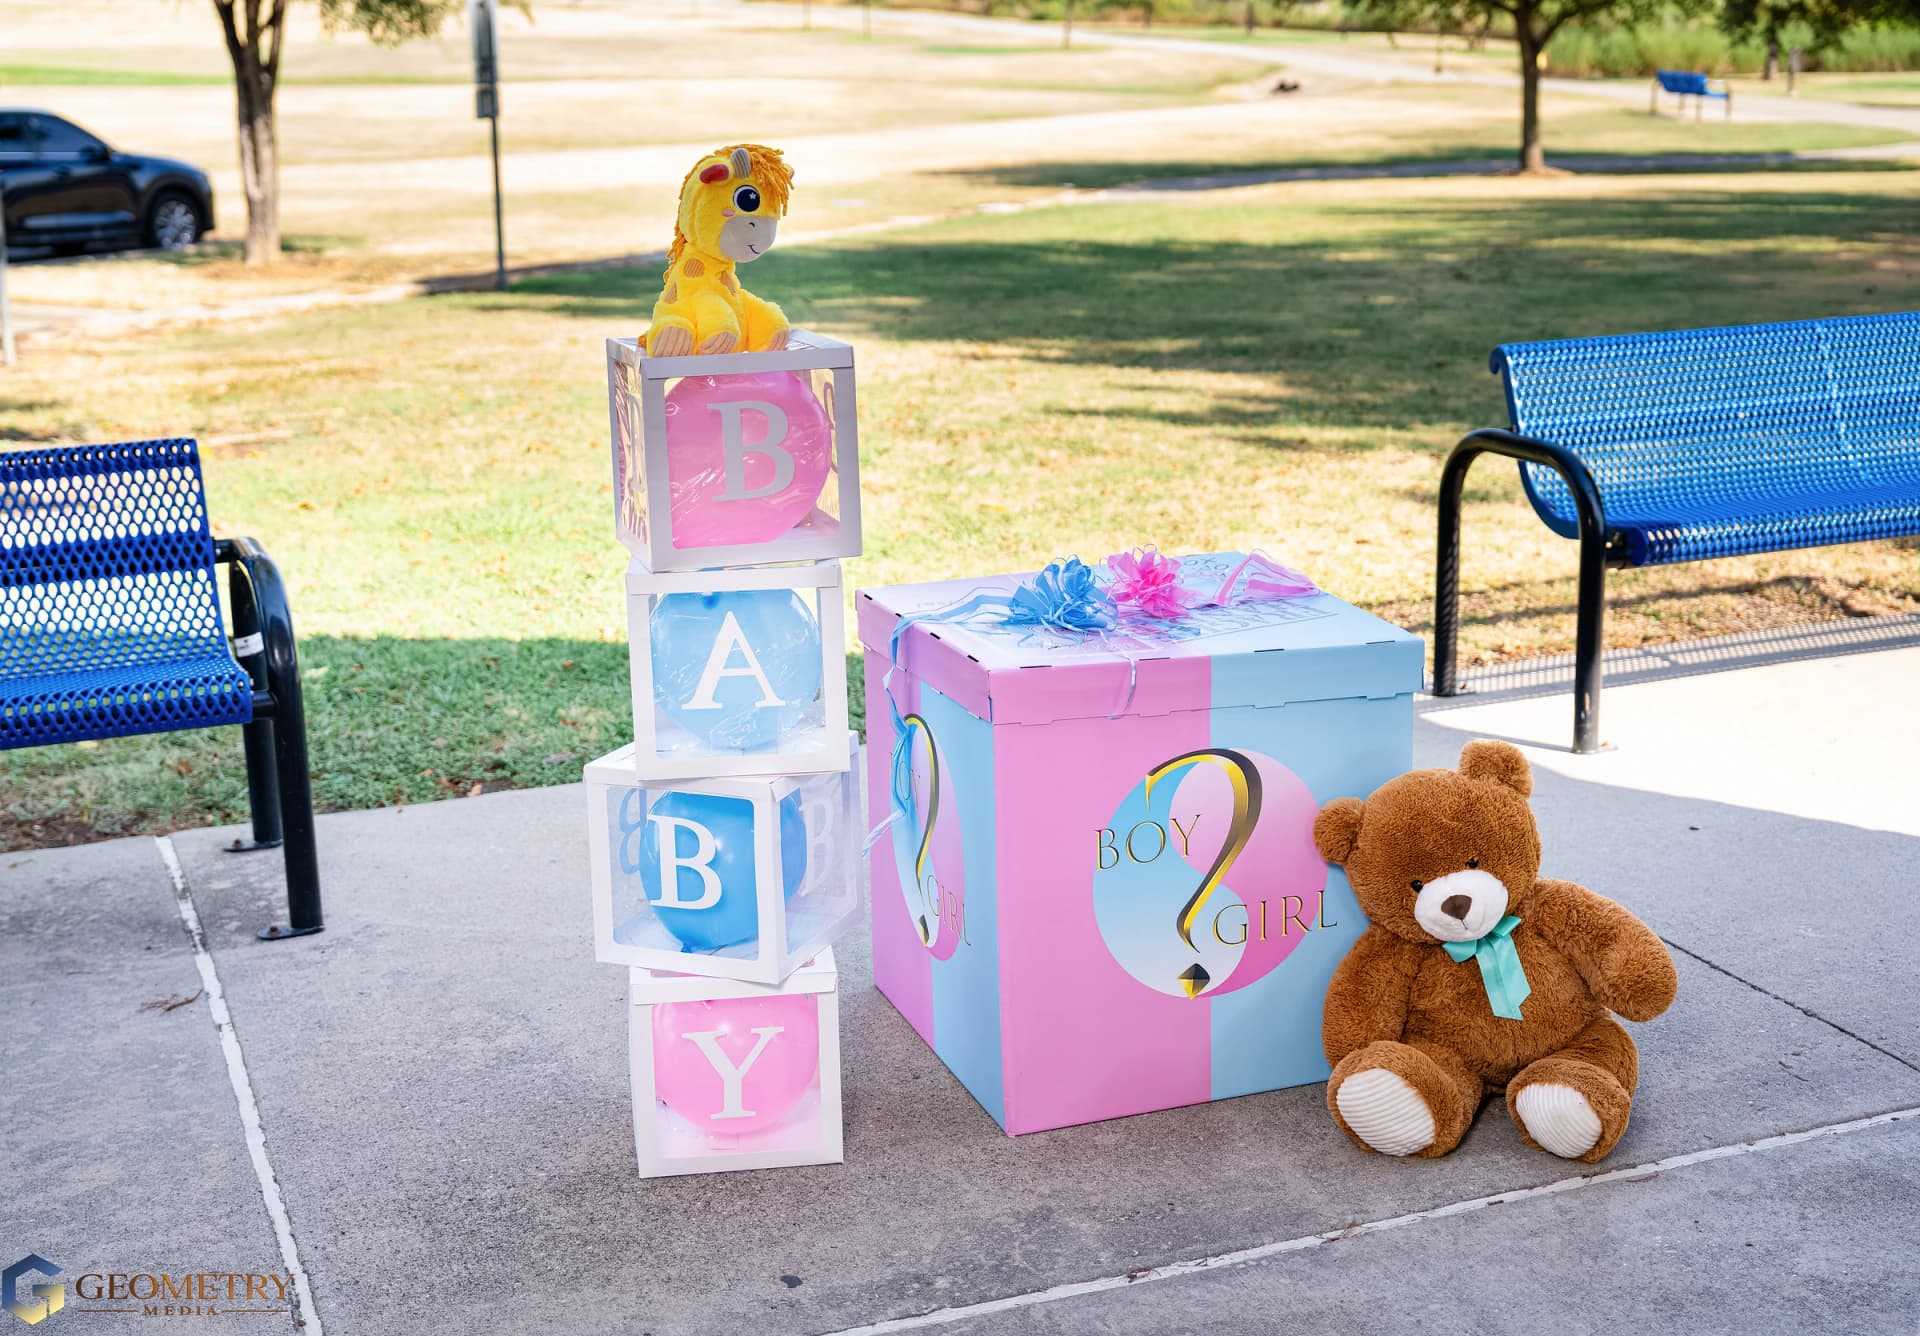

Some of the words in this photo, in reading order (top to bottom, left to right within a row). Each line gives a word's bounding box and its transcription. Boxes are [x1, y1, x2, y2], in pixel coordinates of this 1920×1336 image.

[707, 401, 796, 502] B
[682, 611, 786, 710] A
[647, 814, 722, 909] B
[1094, 814, 1201, 872] BOY
[927, 875, 971, 947] GIRL
[1213, 889, 1338, 946] GIRL
[682, 1026, 784, 1120] Y
